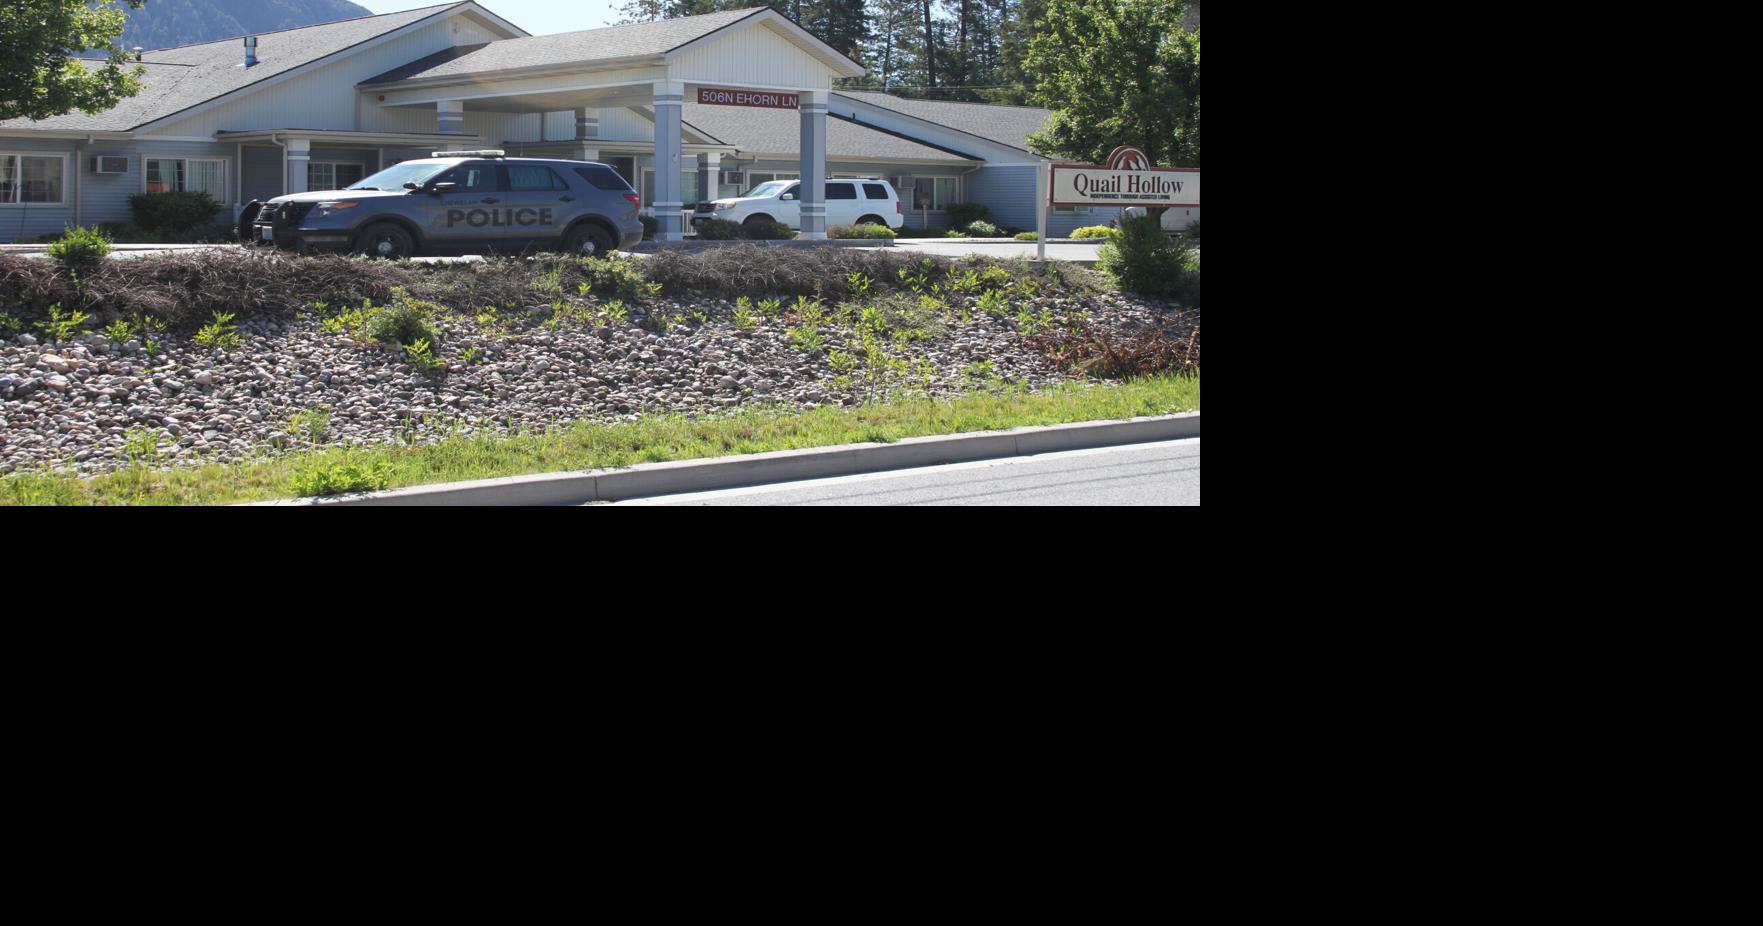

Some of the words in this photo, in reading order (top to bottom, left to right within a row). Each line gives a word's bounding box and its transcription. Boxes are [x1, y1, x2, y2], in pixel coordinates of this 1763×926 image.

[736, 94, 778, 105] EHORN
[782, 97, 797, 107] LN
[1073, 173, 1120, 196] Quail
[1127, 174, 1184, 194] Hollow
[447, 208, 552, 227] POLICE
